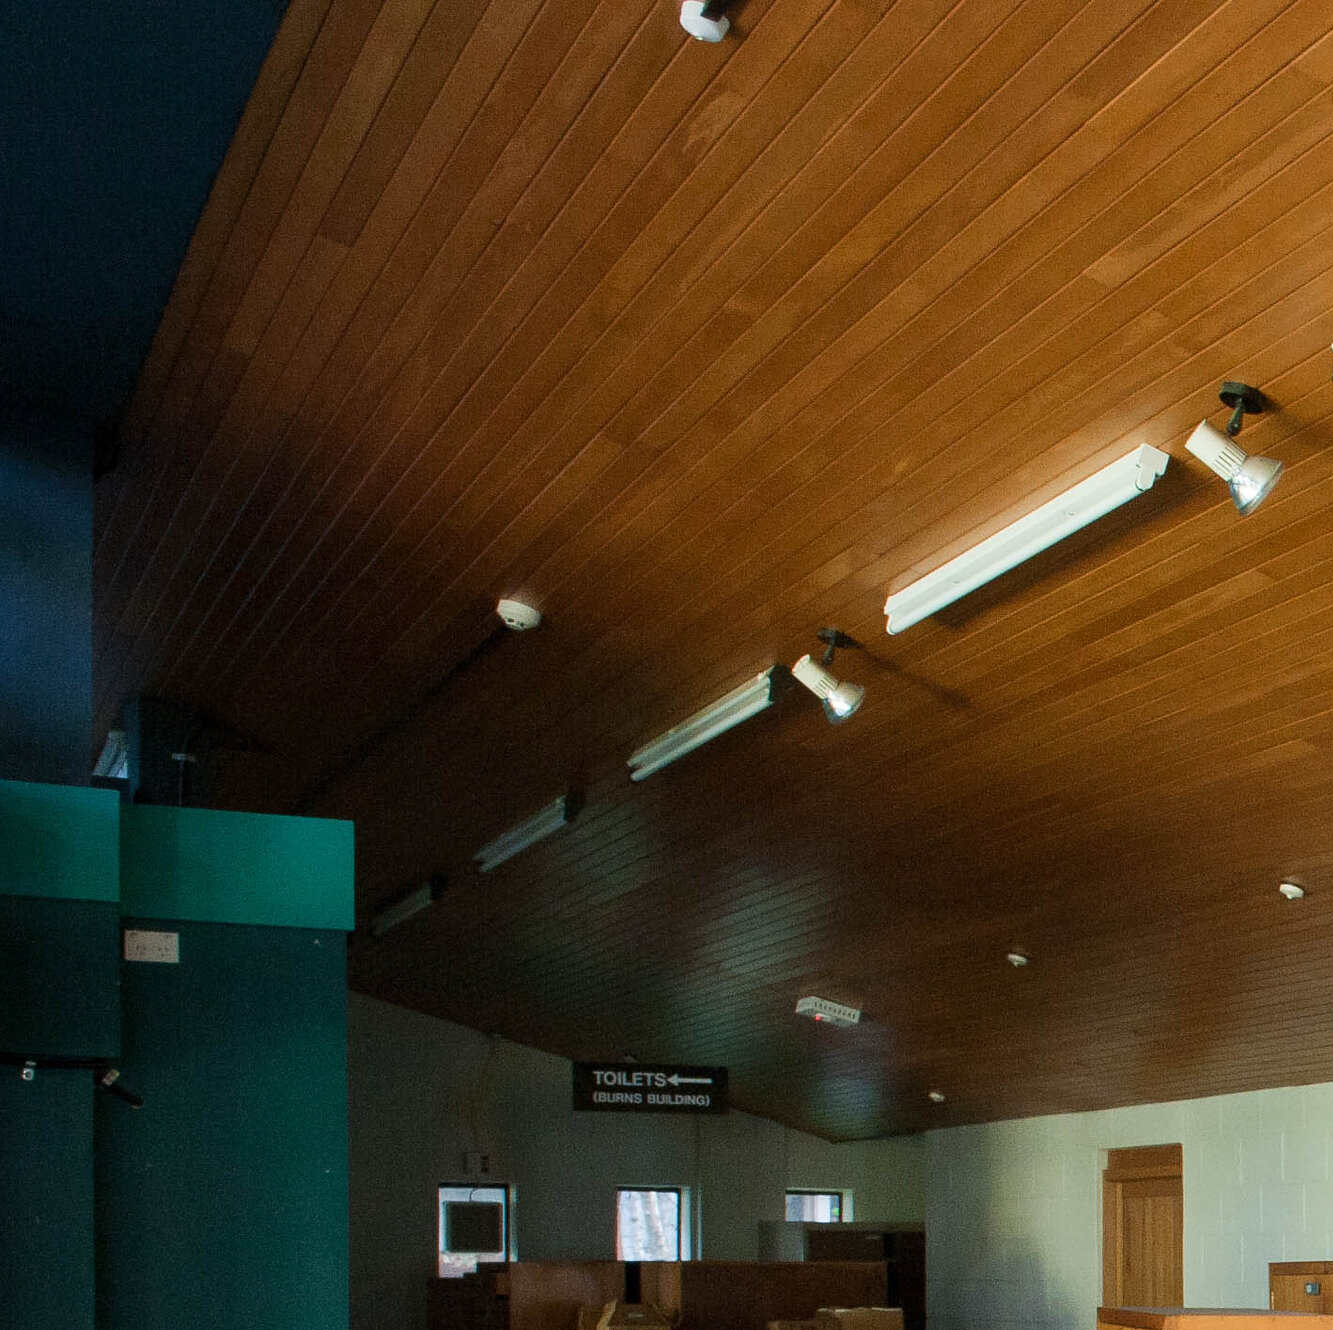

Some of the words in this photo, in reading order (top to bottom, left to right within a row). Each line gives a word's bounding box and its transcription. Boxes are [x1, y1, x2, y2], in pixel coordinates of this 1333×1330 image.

[593, 1071, 667, 1087] TOILETS
[592, 1091, 643, 1105] (BURNS
[647, 1093, 711, 1107] BUILDING)
